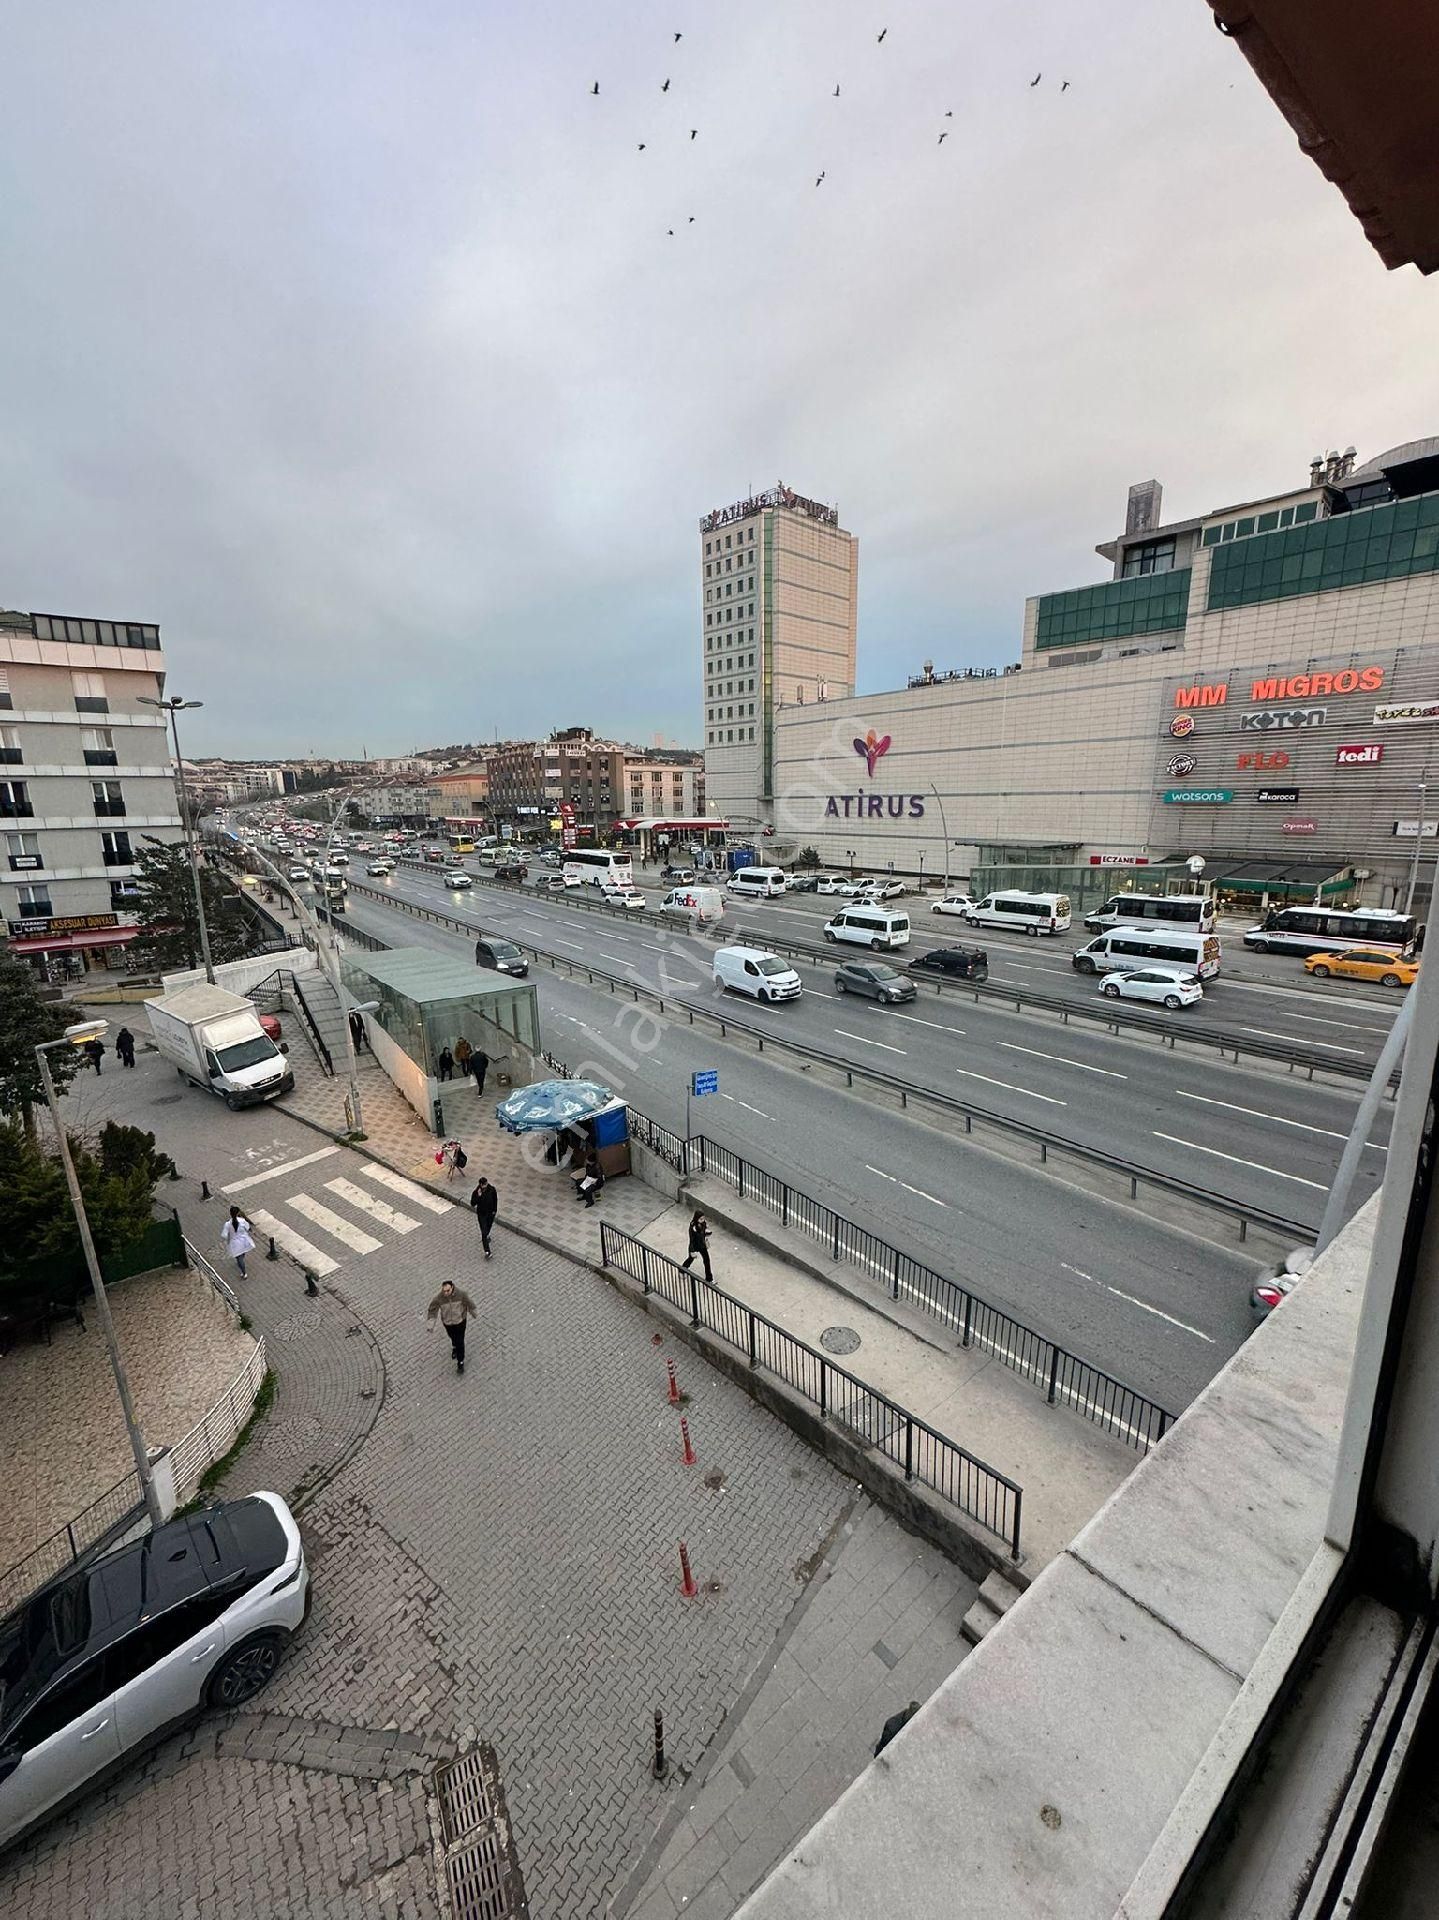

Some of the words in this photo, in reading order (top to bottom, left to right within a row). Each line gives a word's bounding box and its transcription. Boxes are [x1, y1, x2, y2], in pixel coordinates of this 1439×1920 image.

[1175, 684, 1227, 708] MM
[1237, 752, 1289, 770] FLO
[824, 788, 924, 818] ATİRUS
[1172, 792, 1224, 801] watsons
[1103, 856, 1135, 864] ECZANE
[674, 892, 698, 908] FedEx
